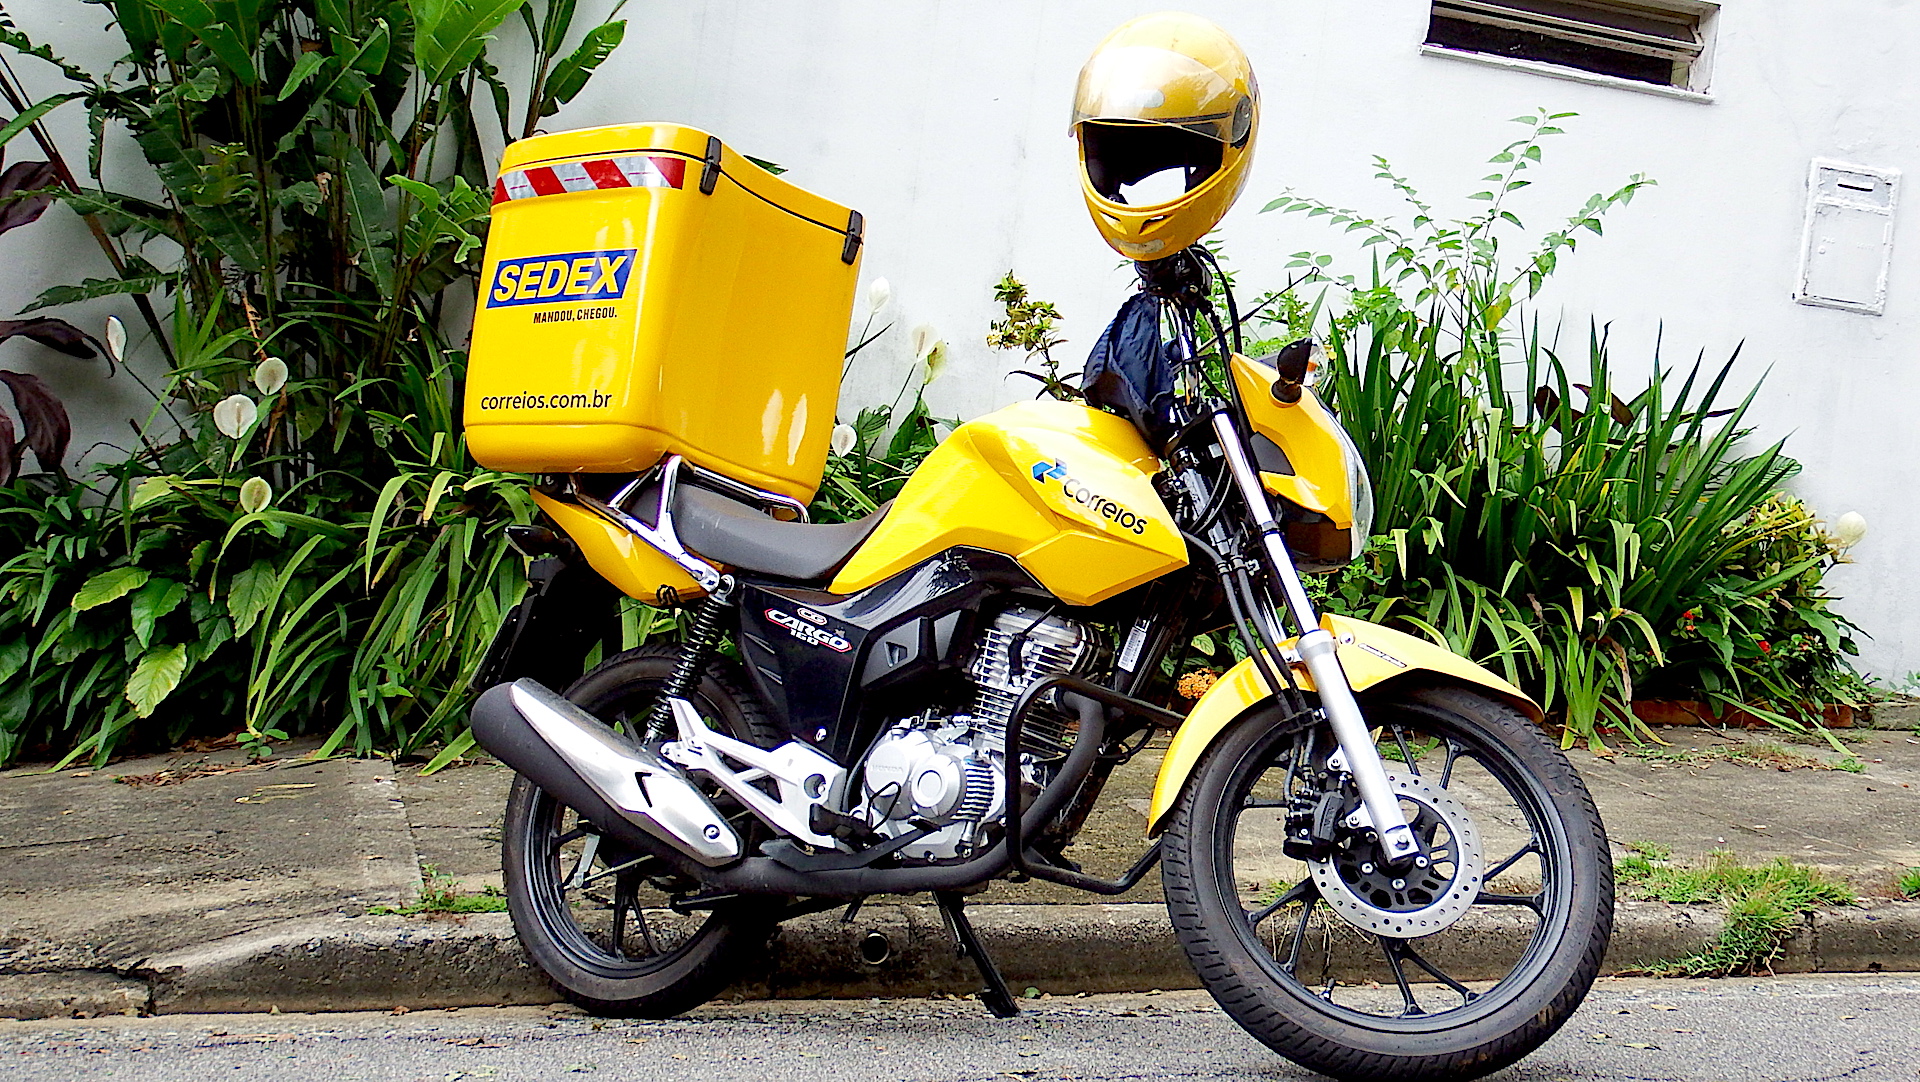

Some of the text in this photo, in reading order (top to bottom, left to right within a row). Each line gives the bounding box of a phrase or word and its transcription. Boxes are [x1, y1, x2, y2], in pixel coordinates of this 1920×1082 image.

[493, 256, 628, 302] SEDEX
[533, 307, 618, 324] MANDOU, CHEGOU.
[481, 389, 613, 410] correios.com.br
[767, 609, 849, 650] CARGO
[790, 628, 819, 646] 160
